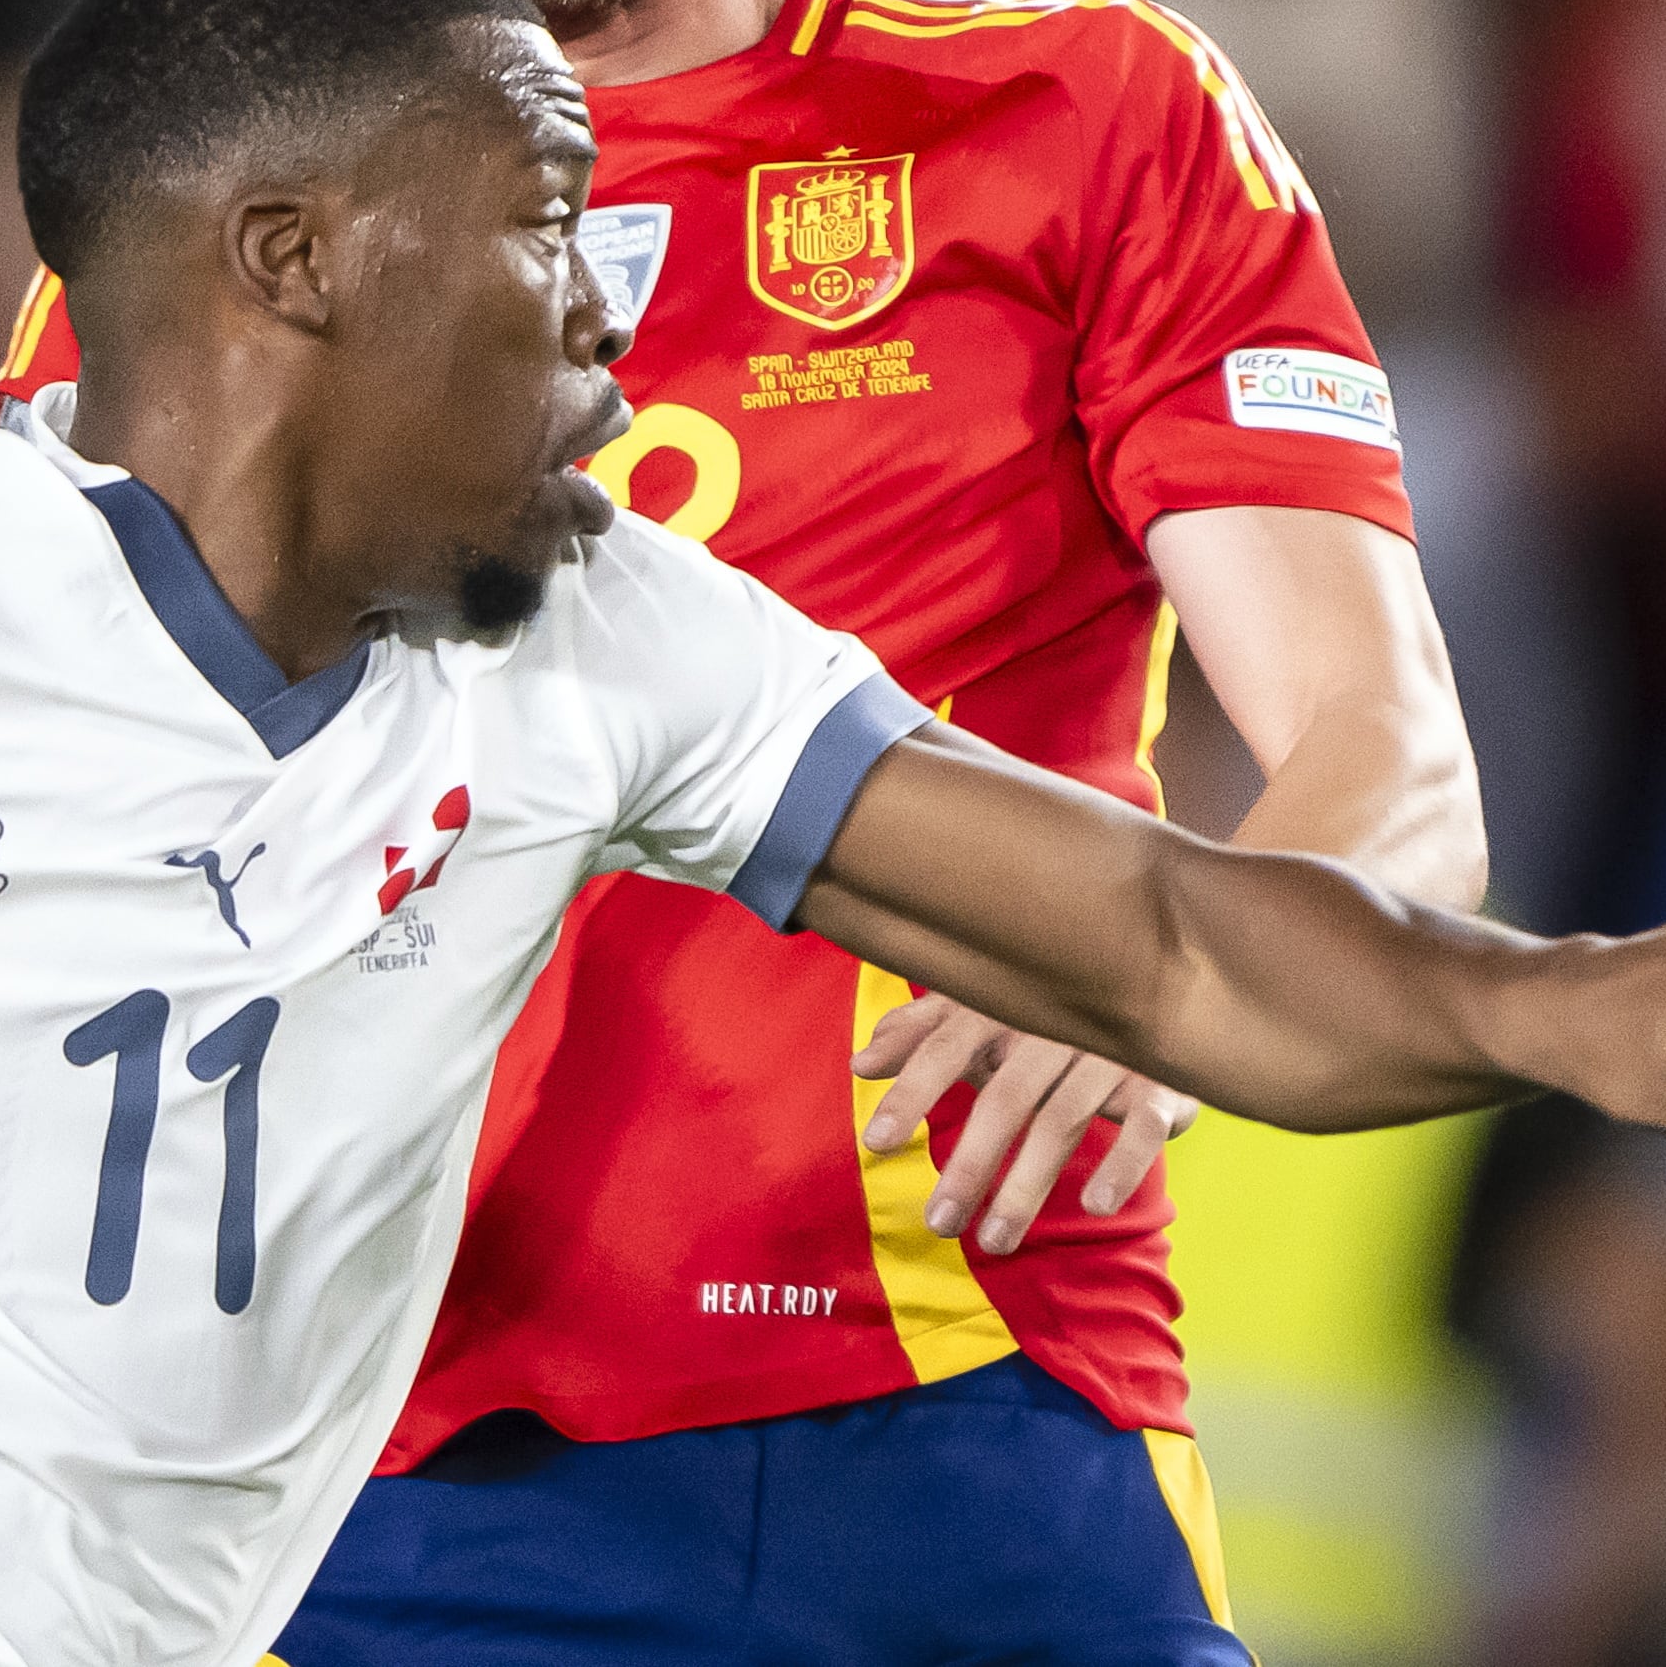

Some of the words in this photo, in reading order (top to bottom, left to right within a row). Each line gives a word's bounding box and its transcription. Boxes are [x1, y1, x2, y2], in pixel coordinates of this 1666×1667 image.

[748, 354, 793, 374] SPAIN
[808, 340, 915, 369] SWITZERLAND
[758, 373, 777, 391] 18
[781, 364, 866, 390] NOVEMBER
[870, 357, 910, 378] 2024
[1235, 353, 1291, 370] UEFA
[741, 390, 791, 410] SANTA
[795, 384, 837, 404] CRUZ
[841, 380, 862, 399] DE
[866, 373, 933, 396] TENERIFE
[347, 928, 381, 955] SP
[403, 922, 436, 949] SUI
[62, 987, 282, 1316] 11
[701, 1282, 839, 1317] HEAT.RDY
